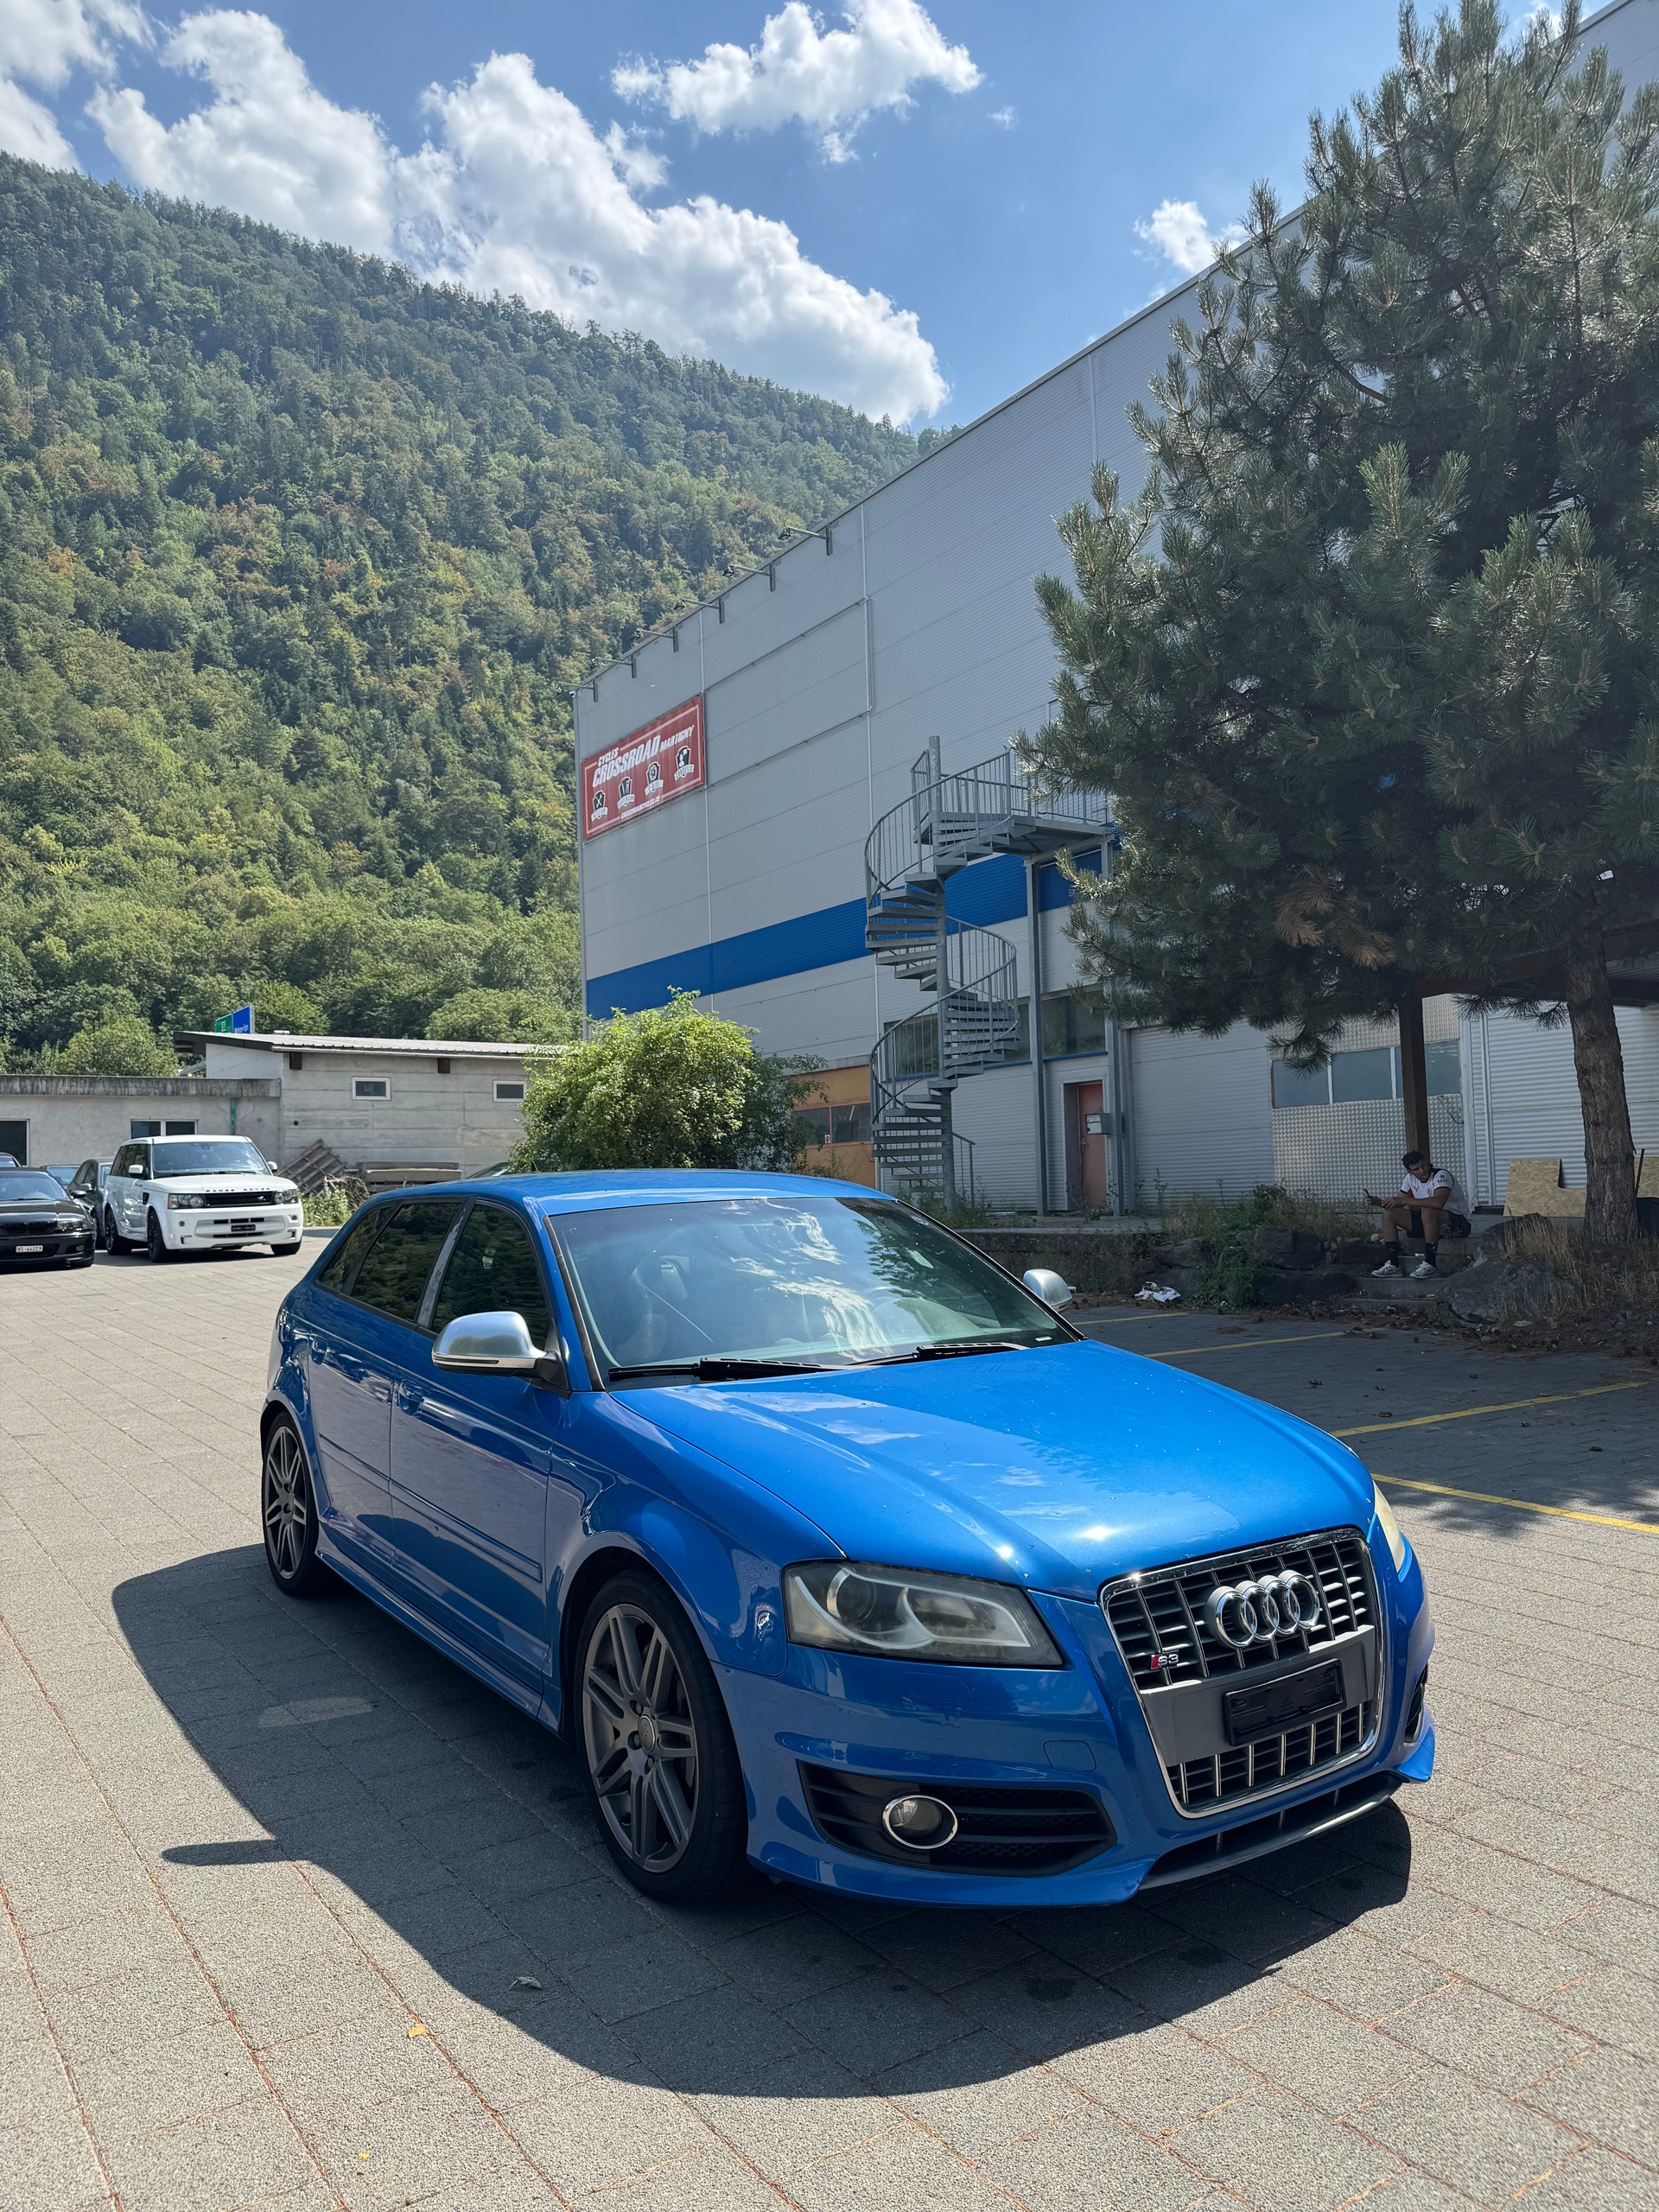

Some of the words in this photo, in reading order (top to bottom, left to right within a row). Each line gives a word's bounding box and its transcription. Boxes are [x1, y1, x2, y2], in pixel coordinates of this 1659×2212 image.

[592, 734, 661, 788] CROSSROAD
[659, 724, 695, 753] MARTIGNY
[598, 747, 619, 766] CYCLES
[1158, 1653, 1179, 1665] S3
